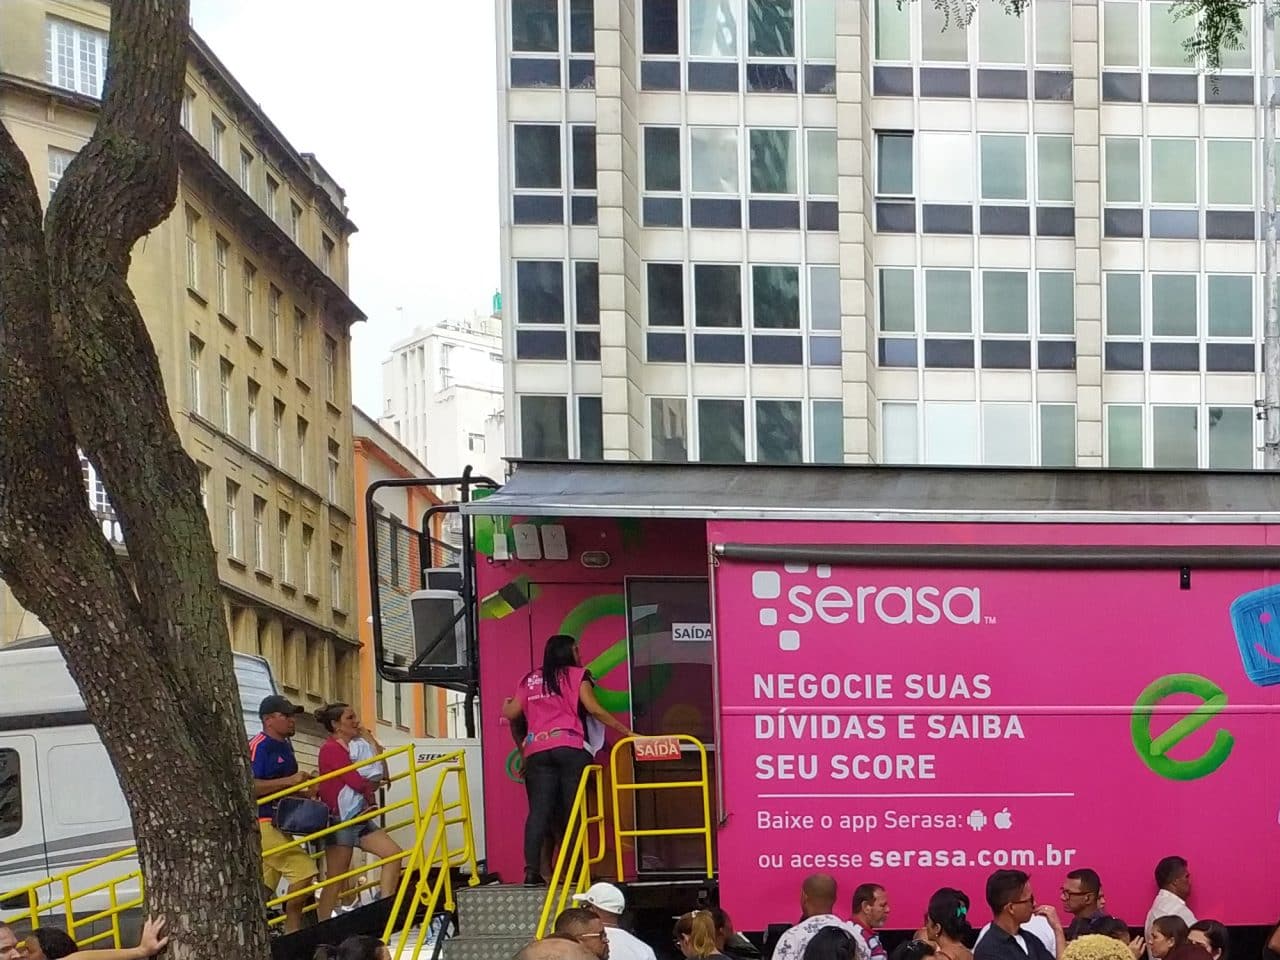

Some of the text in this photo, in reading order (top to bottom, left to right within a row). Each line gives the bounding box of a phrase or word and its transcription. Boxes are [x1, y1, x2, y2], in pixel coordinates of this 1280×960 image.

[788, 585, 980, 625] serasa
[674, 625, 712, 639] SAÍDA
[753, 673, 992, 699] NEGOCIE SUAS
[754, 708, 1025, 740] DÍVIDAS E SAIBA
[636, 740, 679, 757] SAÍDA
[755, 754, 936, 780] SEU SCORE
[757, 810, 962, 833] Baixe o app Serasa:
[758, 843, 1076, 868] ou acesse serasa.com.br
